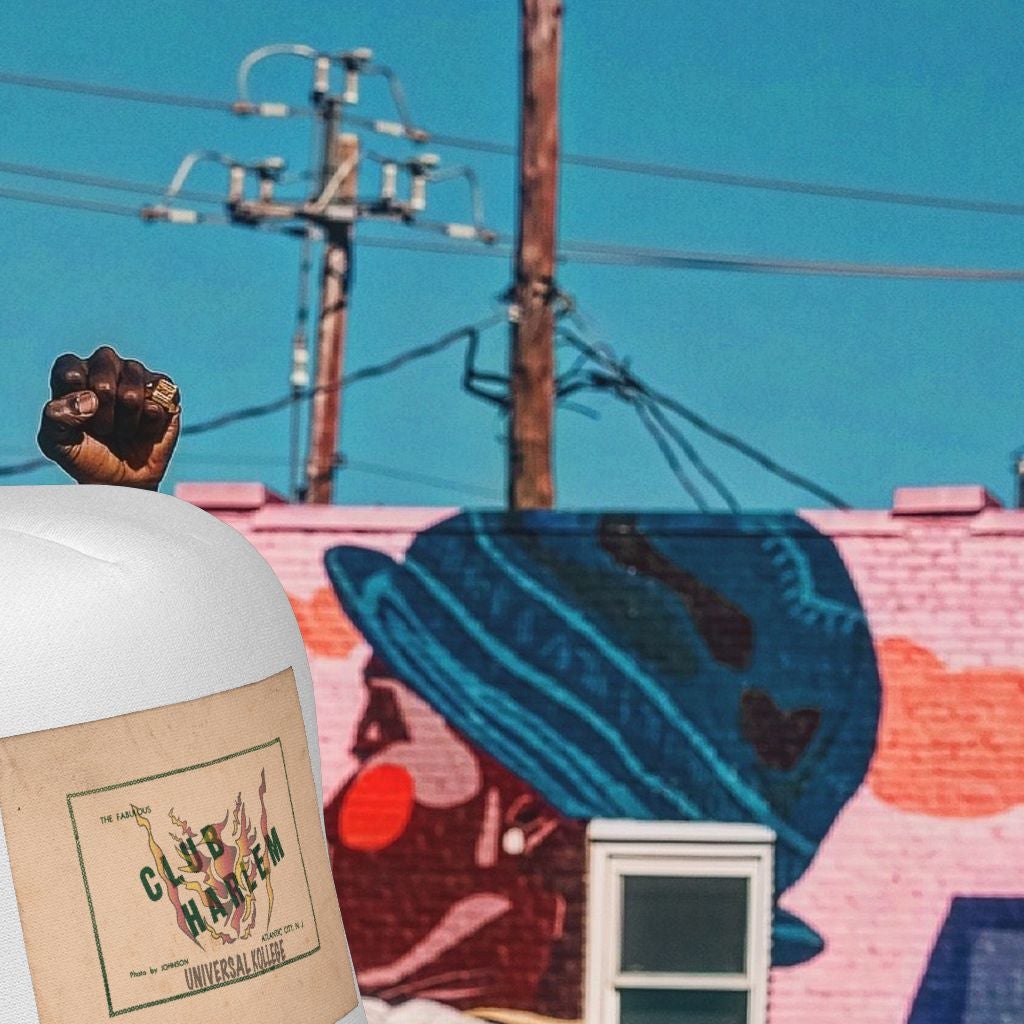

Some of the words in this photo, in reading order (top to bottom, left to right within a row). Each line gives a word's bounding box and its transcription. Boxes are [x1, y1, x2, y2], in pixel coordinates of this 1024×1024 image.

[99, 814, 114, 825] THE
[139, 824, 225, 902] CLUB
[180, 826, 285, 938] HARLEM
[129, 970, 147, 979] Photo
[149, 966, 158, 976] by
[161, 959, 189, 972] JOHNSON
[183, 952, 252, 990] UNIVERSAL
[250, 938, 286, 973] KOLLEGE
